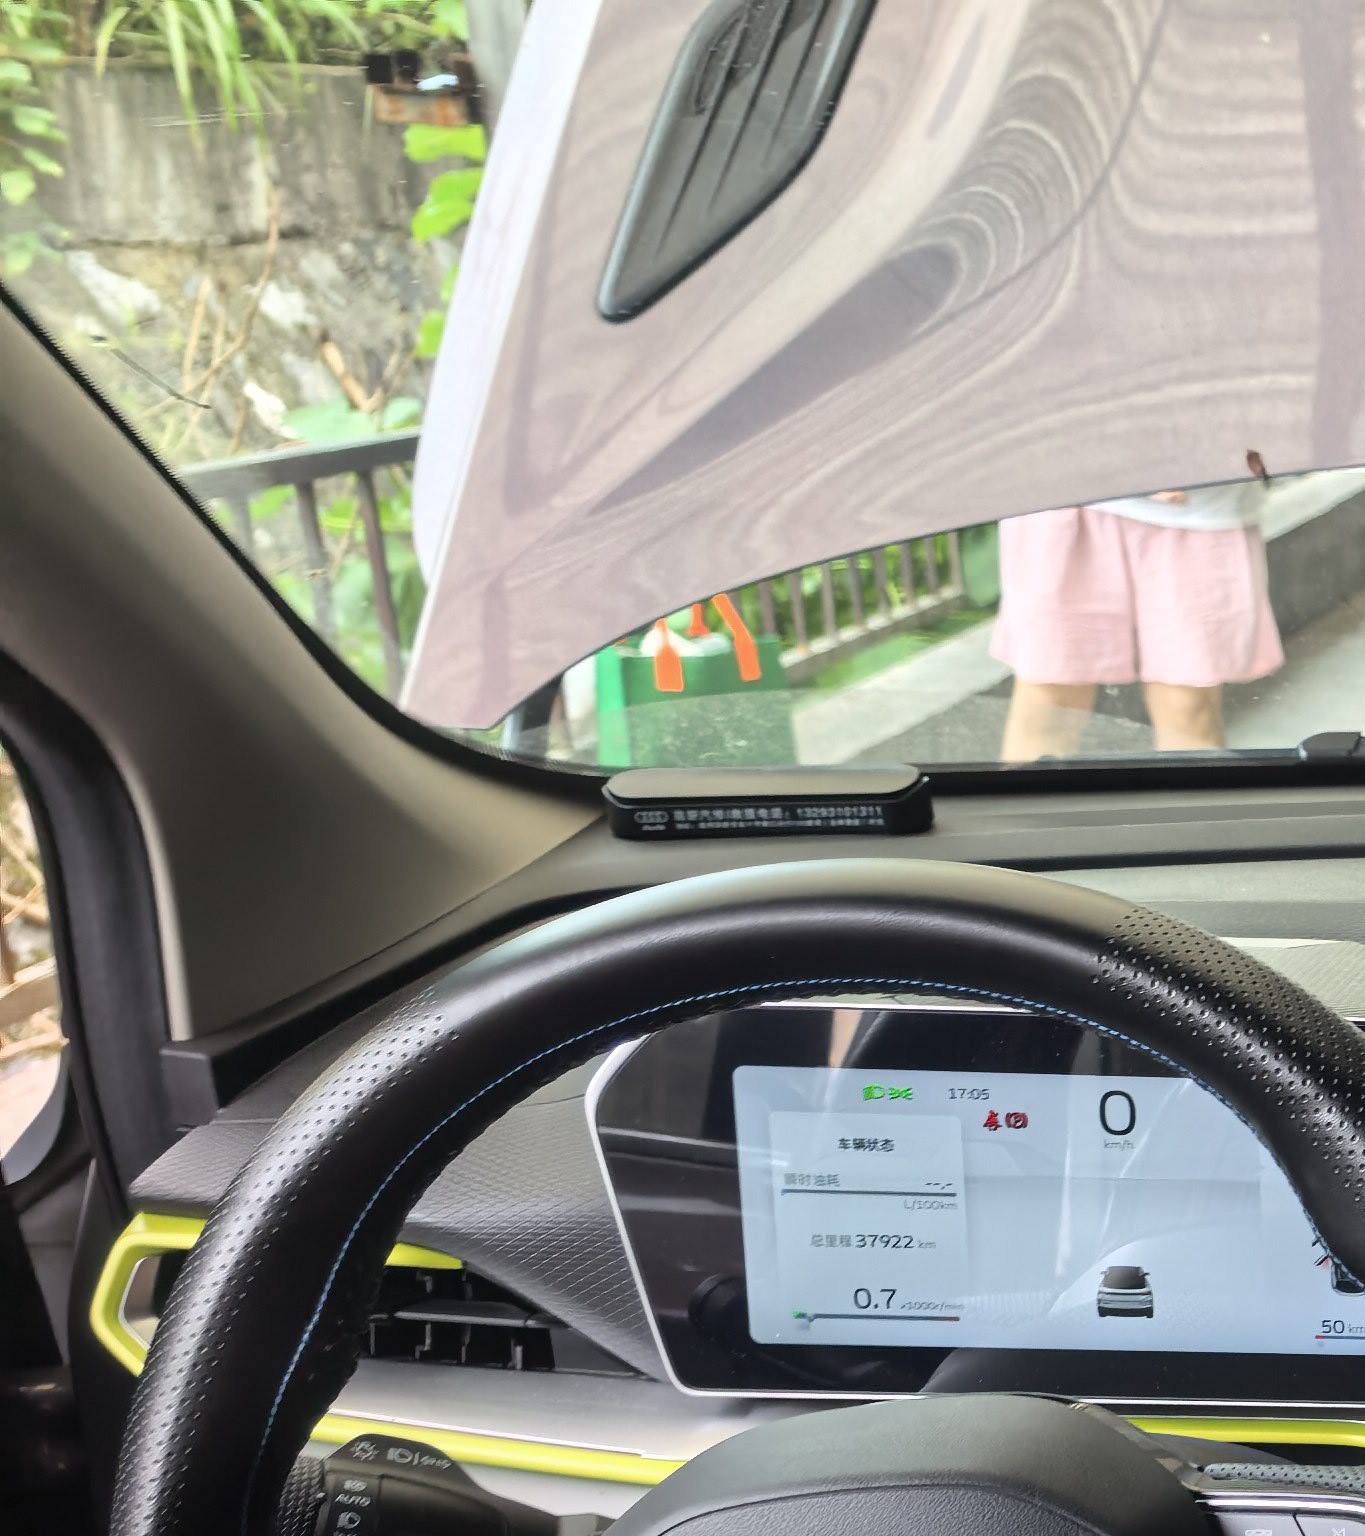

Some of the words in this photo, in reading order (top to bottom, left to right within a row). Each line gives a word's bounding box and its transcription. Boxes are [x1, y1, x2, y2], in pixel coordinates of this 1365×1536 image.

[1099, 1089, 1137, 1136] 0
[855, 1233, 915, 1249] 37922
[853, 1287, 898, 1310] 0.7
[1321, 1319, 1346, 1335] 50
